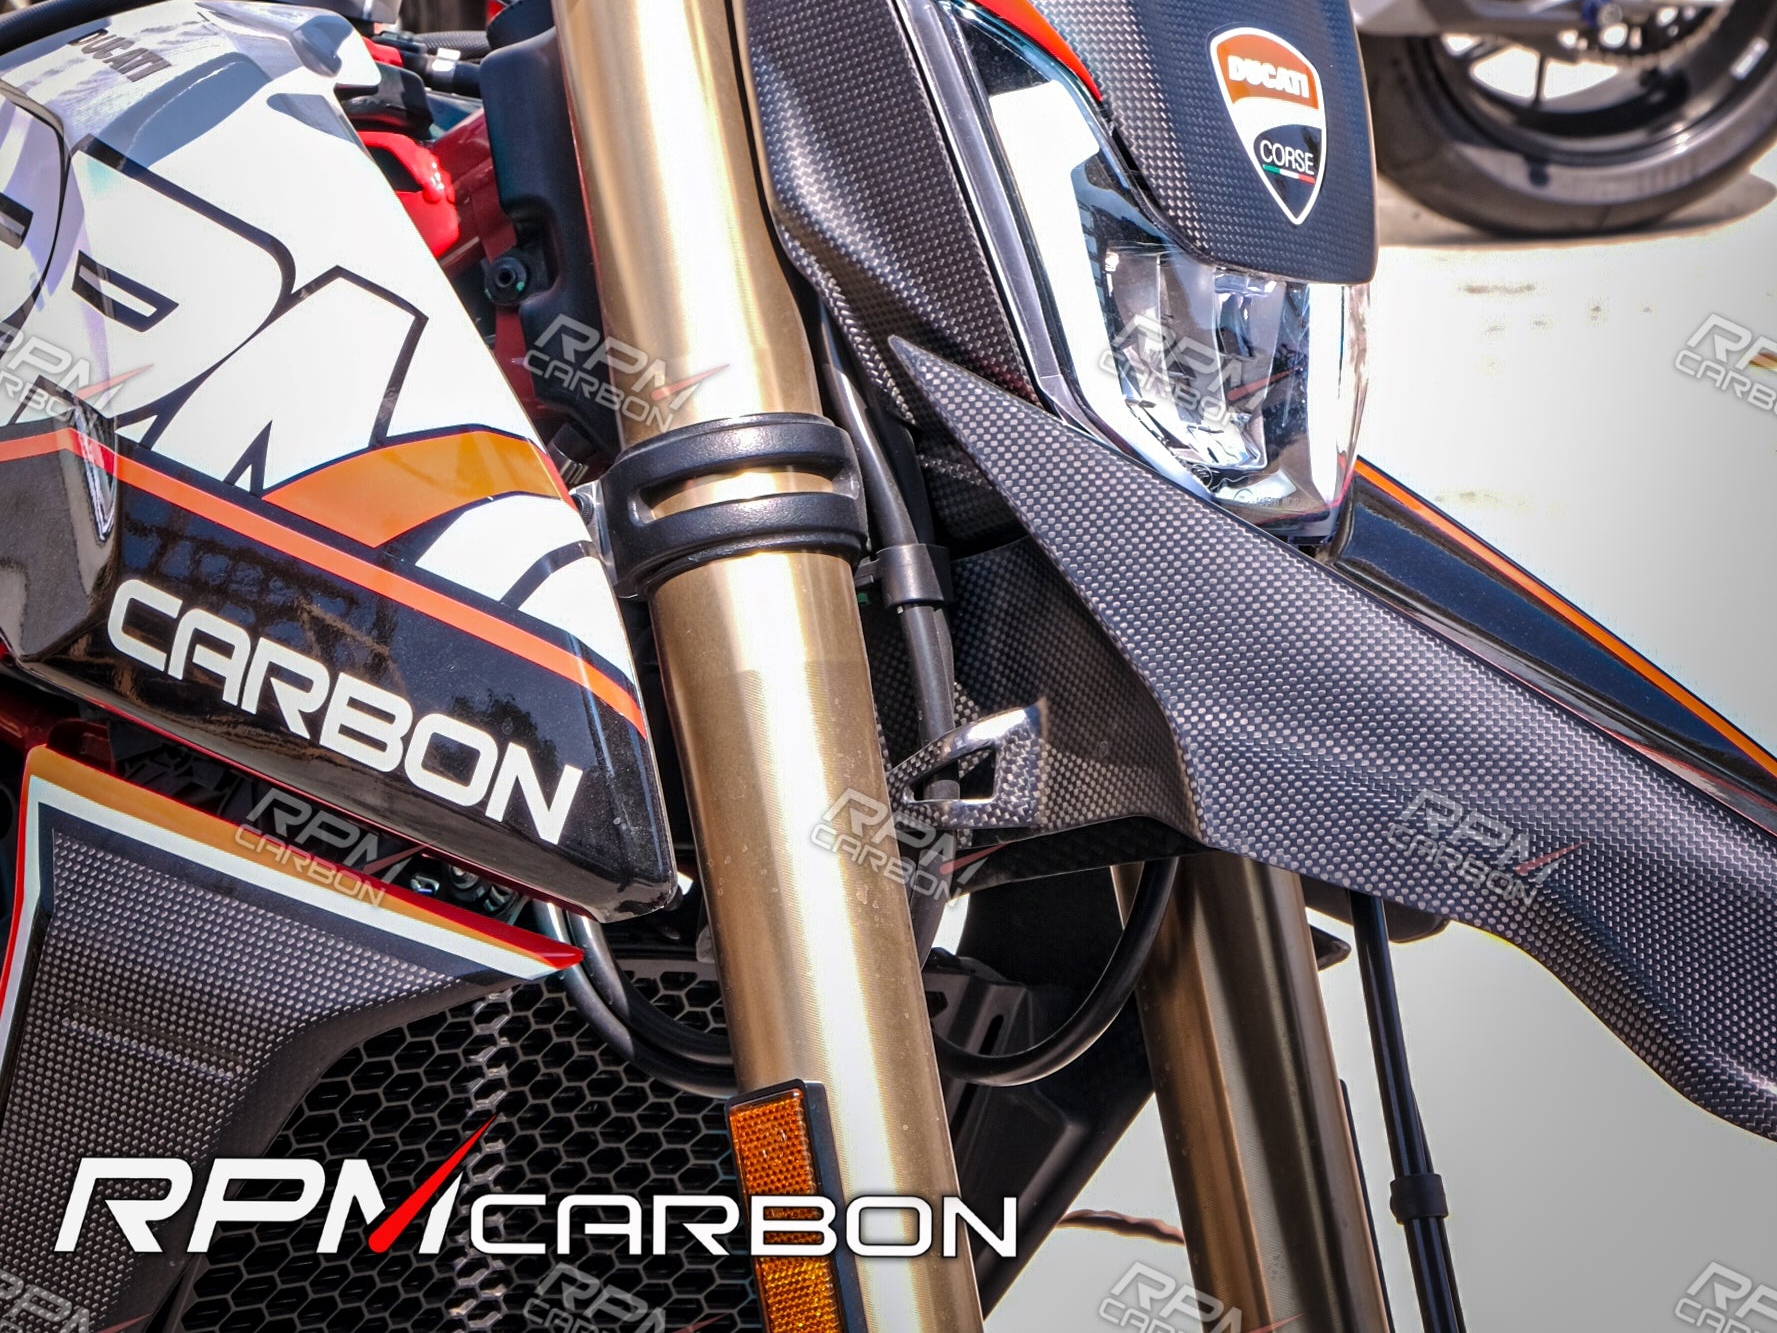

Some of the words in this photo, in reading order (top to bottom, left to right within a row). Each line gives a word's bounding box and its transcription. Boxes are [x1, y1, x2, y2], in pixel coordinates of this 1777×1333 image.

[67, 28, 172, 83] DUCATI
[1227, 55, 1310, 99] DUCATI
[1259, 139, 1315, 176] CORSE
[107, 579, 582, 846] CARBON
